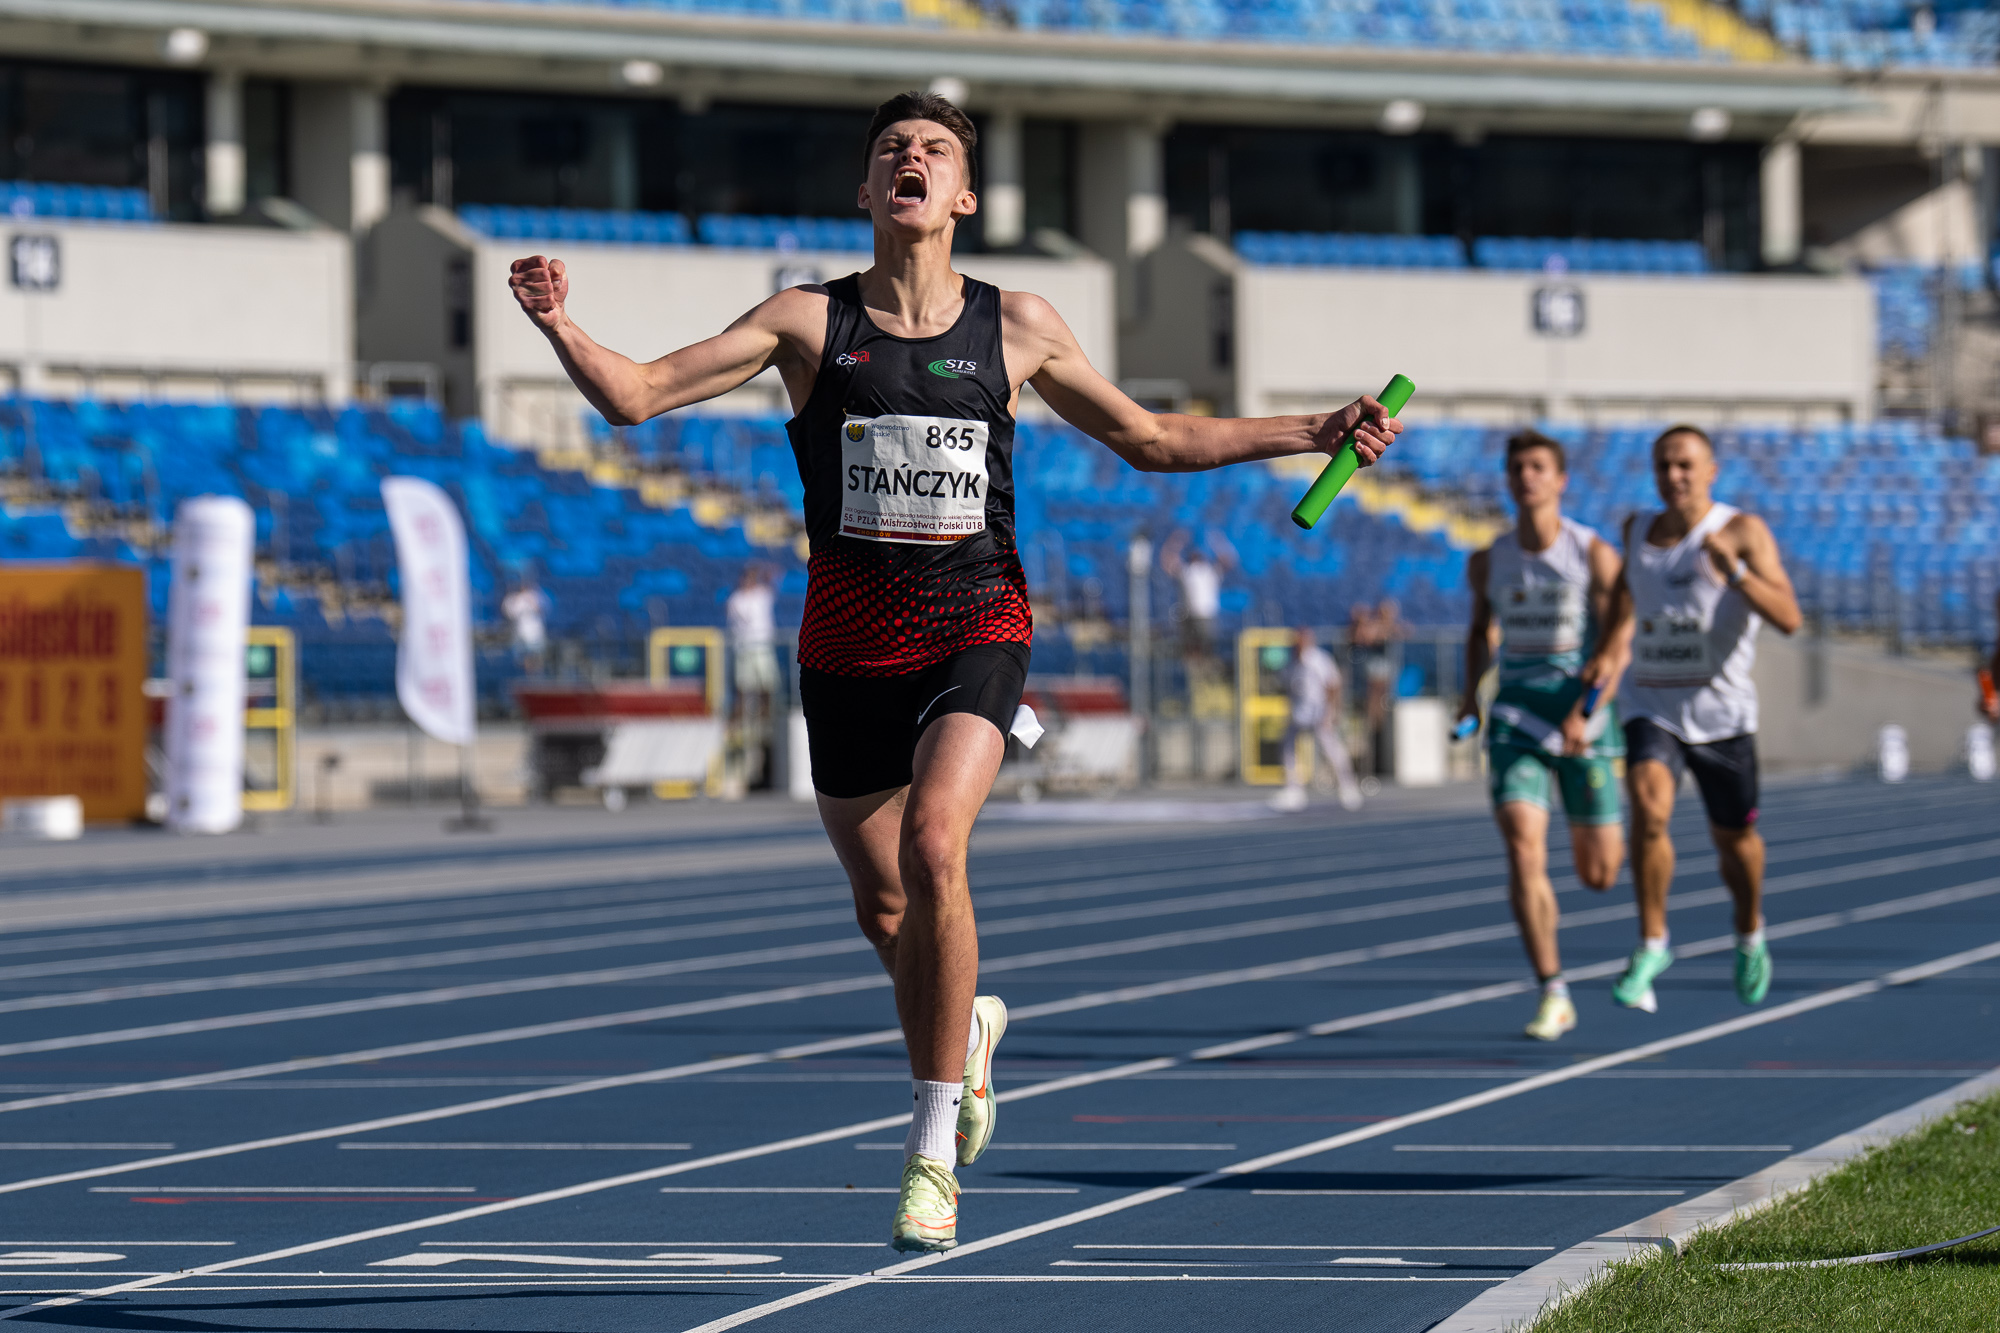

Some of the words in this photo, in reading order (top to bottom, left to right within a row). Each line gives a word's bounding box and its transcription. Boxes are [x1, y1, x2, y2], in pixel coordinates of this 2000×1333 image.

[944, 358, 977, 371] STS
[925, 424, 975, 452] 865
[848, 463, 981, 498] STAŃCZYK
[854, 509, 888, 517] Ogólnopolska
[843, 513, 855, 523] 55.
[857, 515, 878, 526] PZLA
[880, 518, 935, 530] Mistrzostwa
[938, 520, 964, 530] Polski
[965, 520, 983, 530] U18
[856, 529, 892, 538] CHORZÓW
